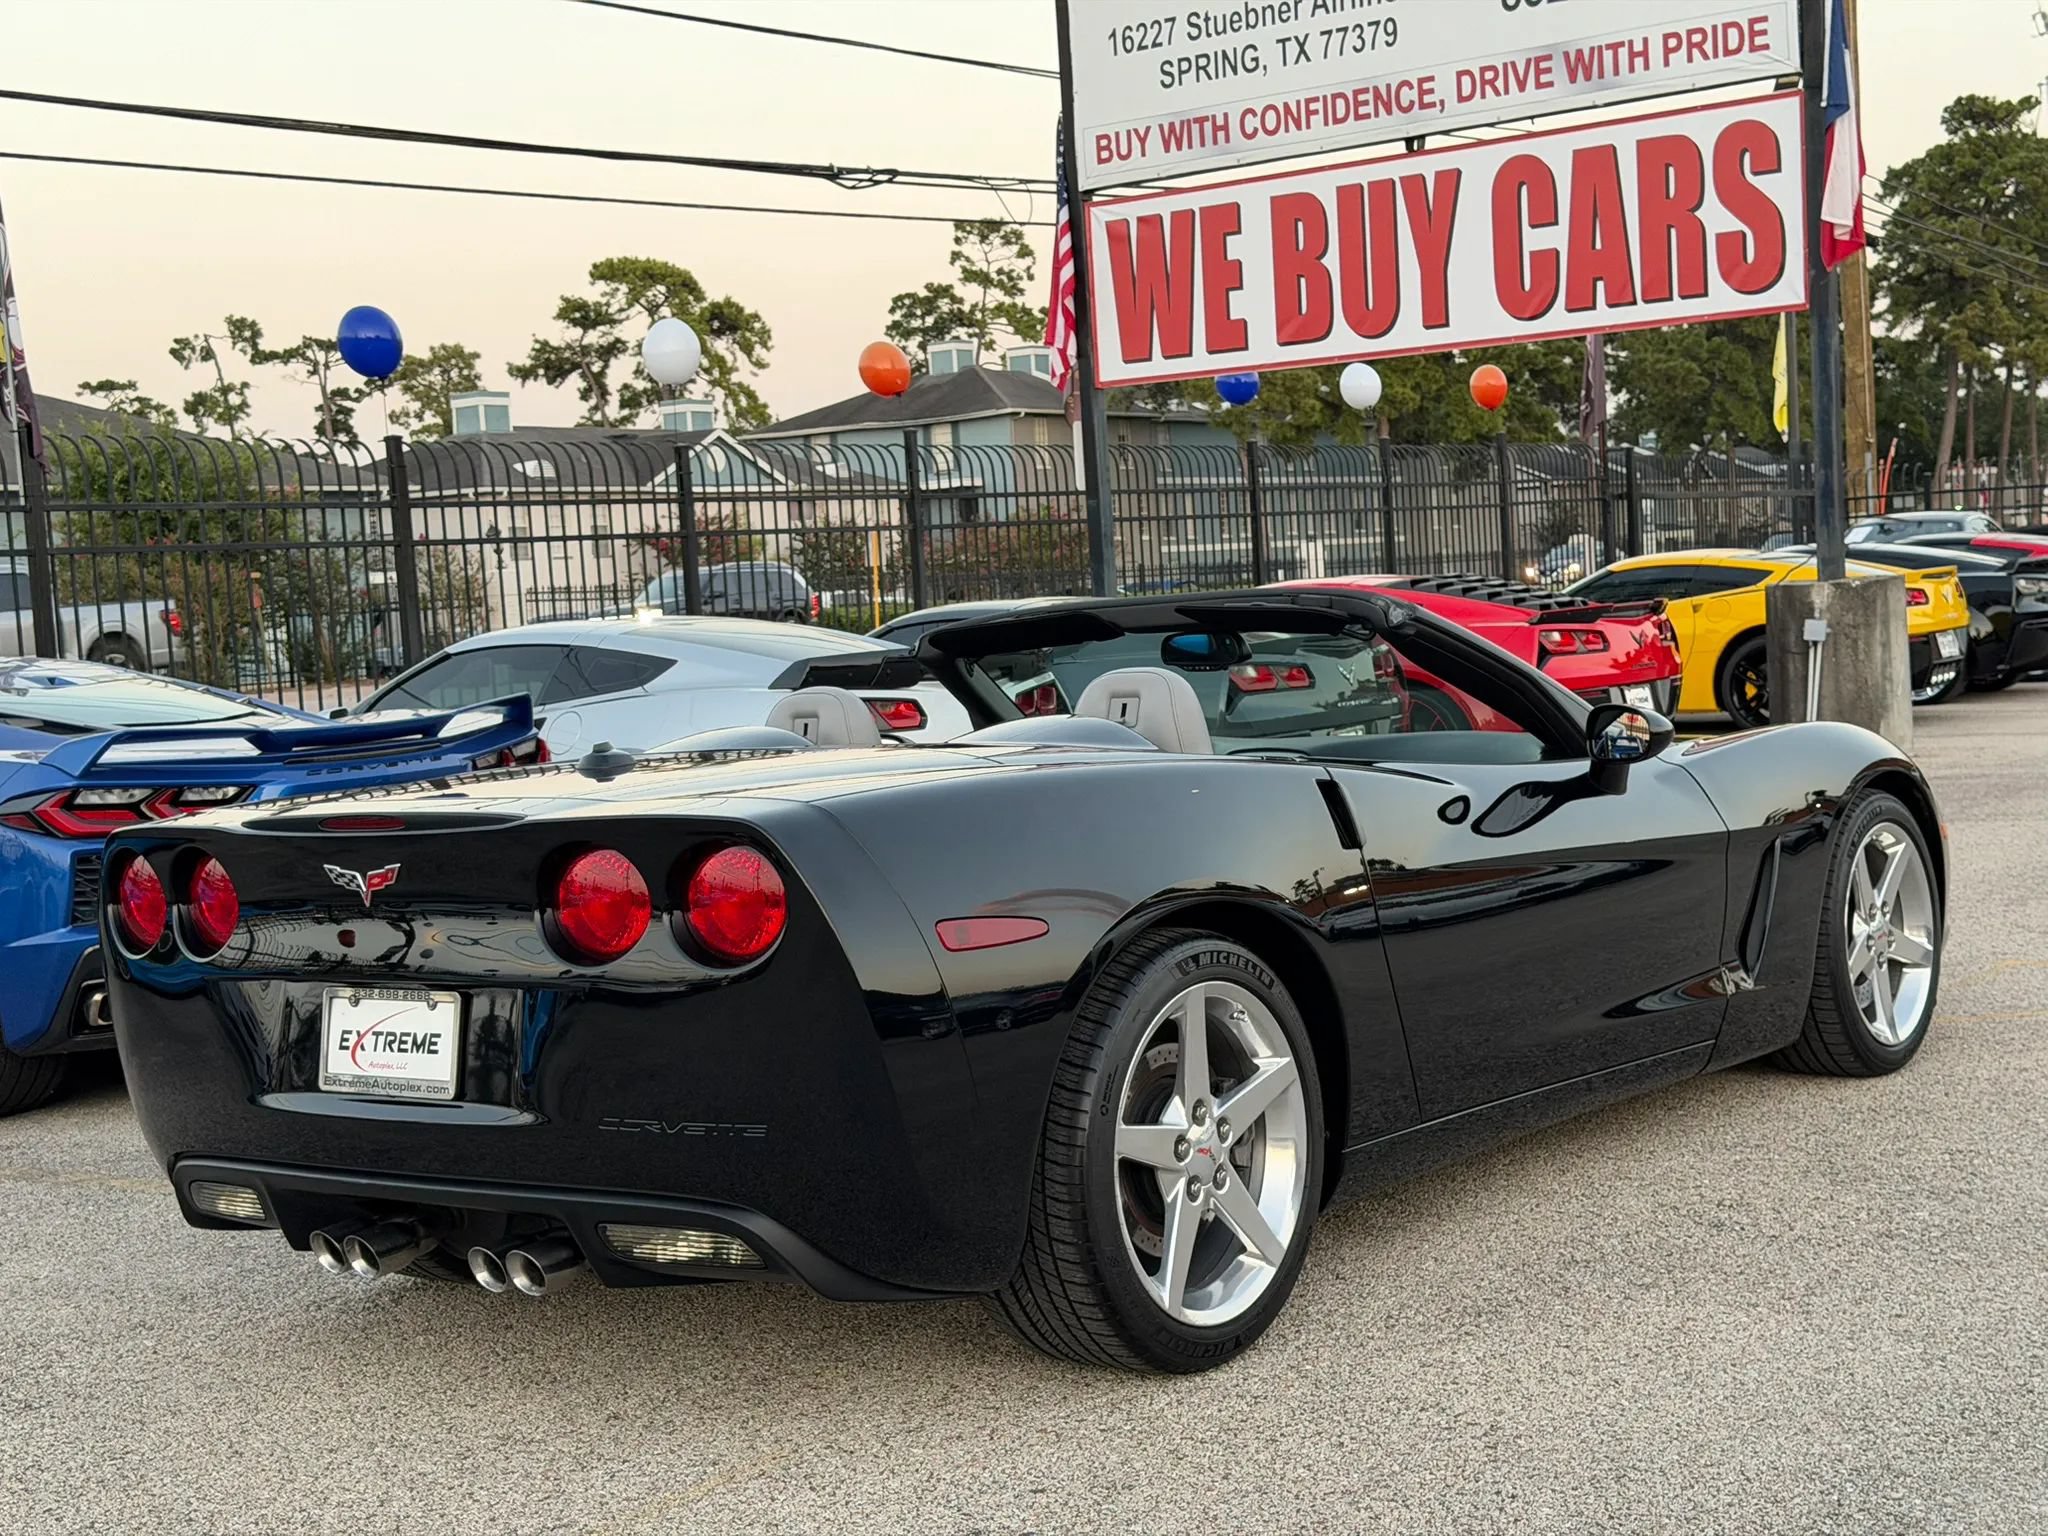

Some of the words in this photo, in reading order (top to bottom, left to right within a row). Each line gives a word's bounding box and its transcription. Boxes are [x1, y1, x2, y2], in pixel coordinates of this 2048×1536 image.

[1107, 16, 1177, 56] 16227
[1186, 0, 1302, 41] Stuebner
[1159, 44, 1268, 89] SPRING,
[1276, 32, 1312, 67] TX
[1319, 16, 1398, 59] 77379
[1095, 125, 1151, 165] BUY
[1158, 112, 1231, 154] WITH
[1239, 76, 1445, 140] CONFIDENCE,
[1455, 54, 1554, 103] DRIVE
[1563, 36, 1650, 84] WITH
[1662, 15, 1770, 68] PRIDE
[1105, 202, 1249, 364] WE
[1270, 167, 1462, 346] BUY
[1491, 119, 1785, 322] CARS
[1198, 951, 1272, 987] MICHELIN
[338, 1030, 441, 1055] EXTREME
[324, 1076, 450, 1095] ExtremeAutoplex.com
